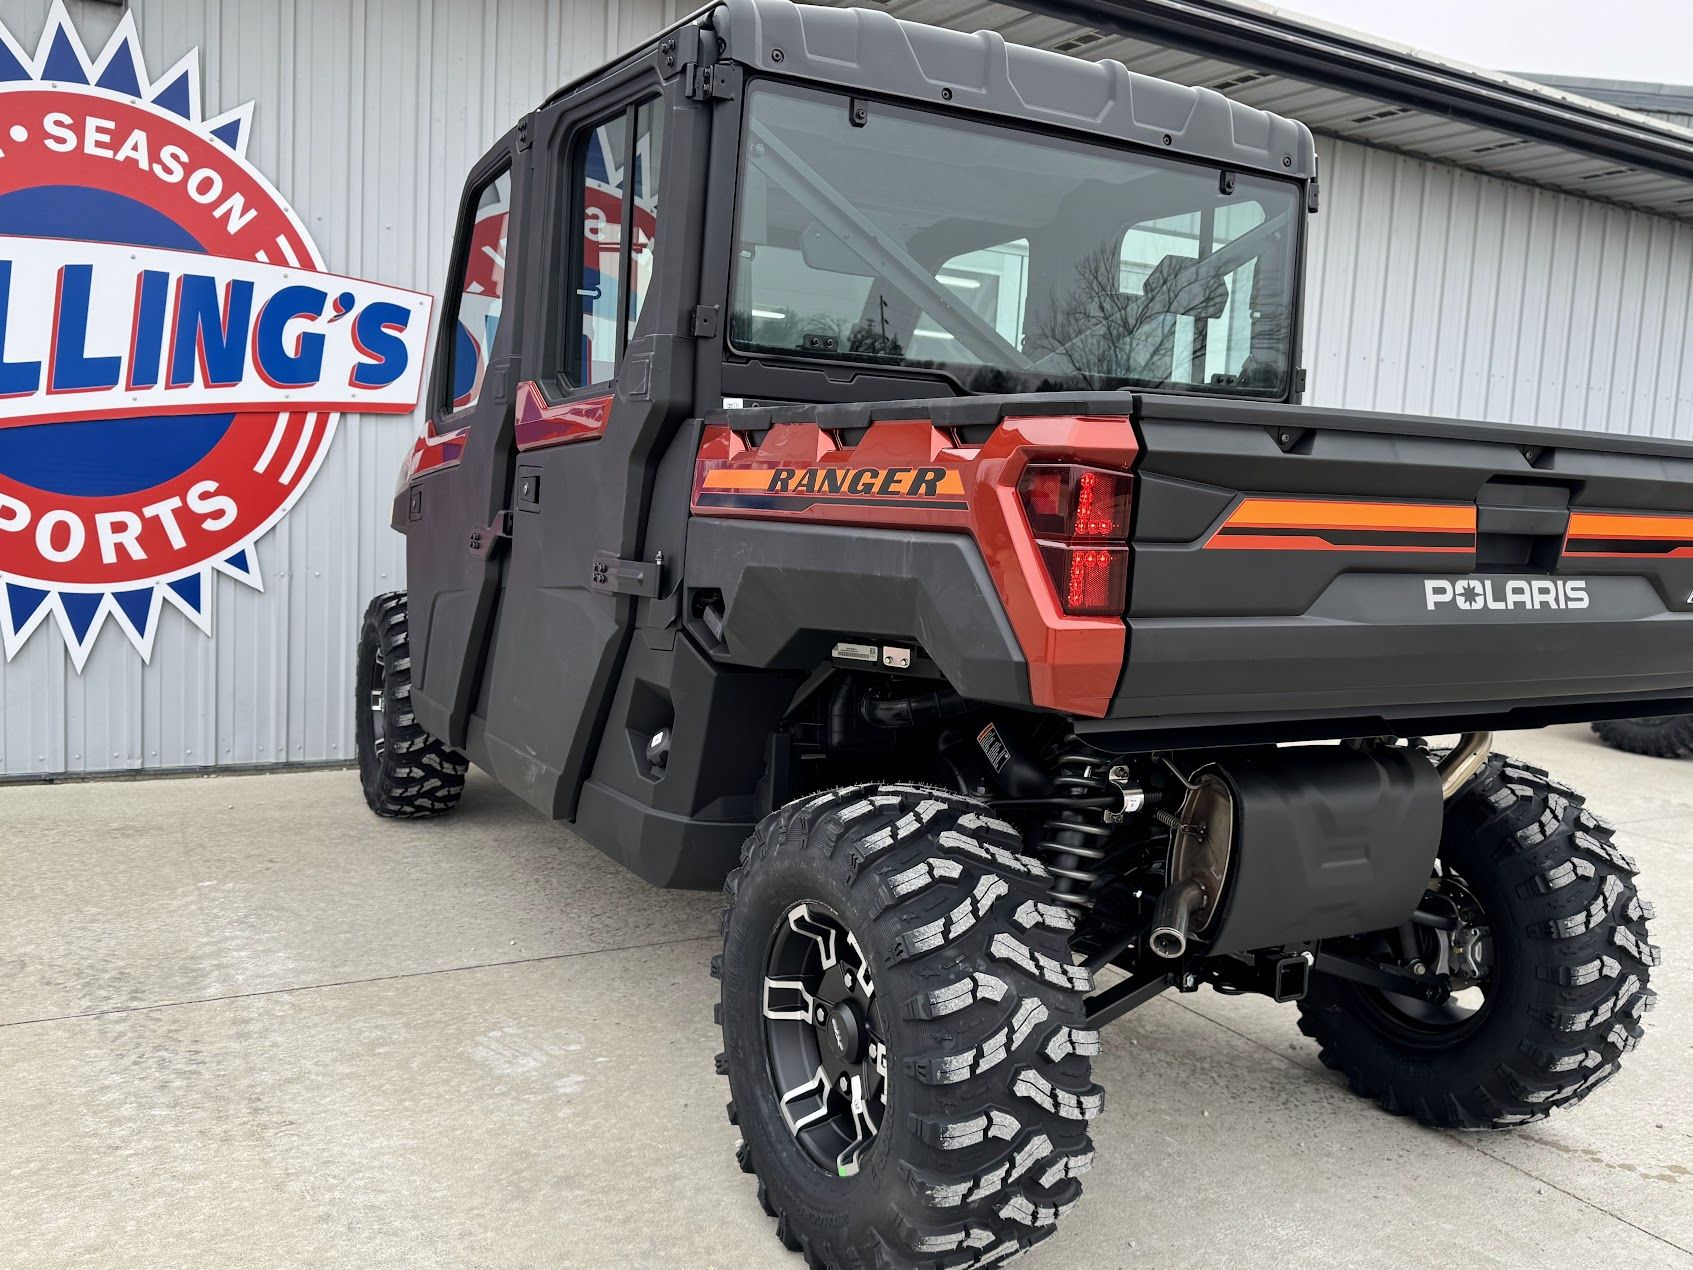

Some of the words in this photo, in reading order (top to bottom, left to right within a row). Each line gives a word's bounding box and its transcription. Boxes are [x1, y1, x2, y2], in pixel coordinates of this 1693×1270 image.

[43, 112, 258, 235] SEASON
[766, 467, 947, 498] RANGER
[1424, 579, 1590, 610] POLARIS
